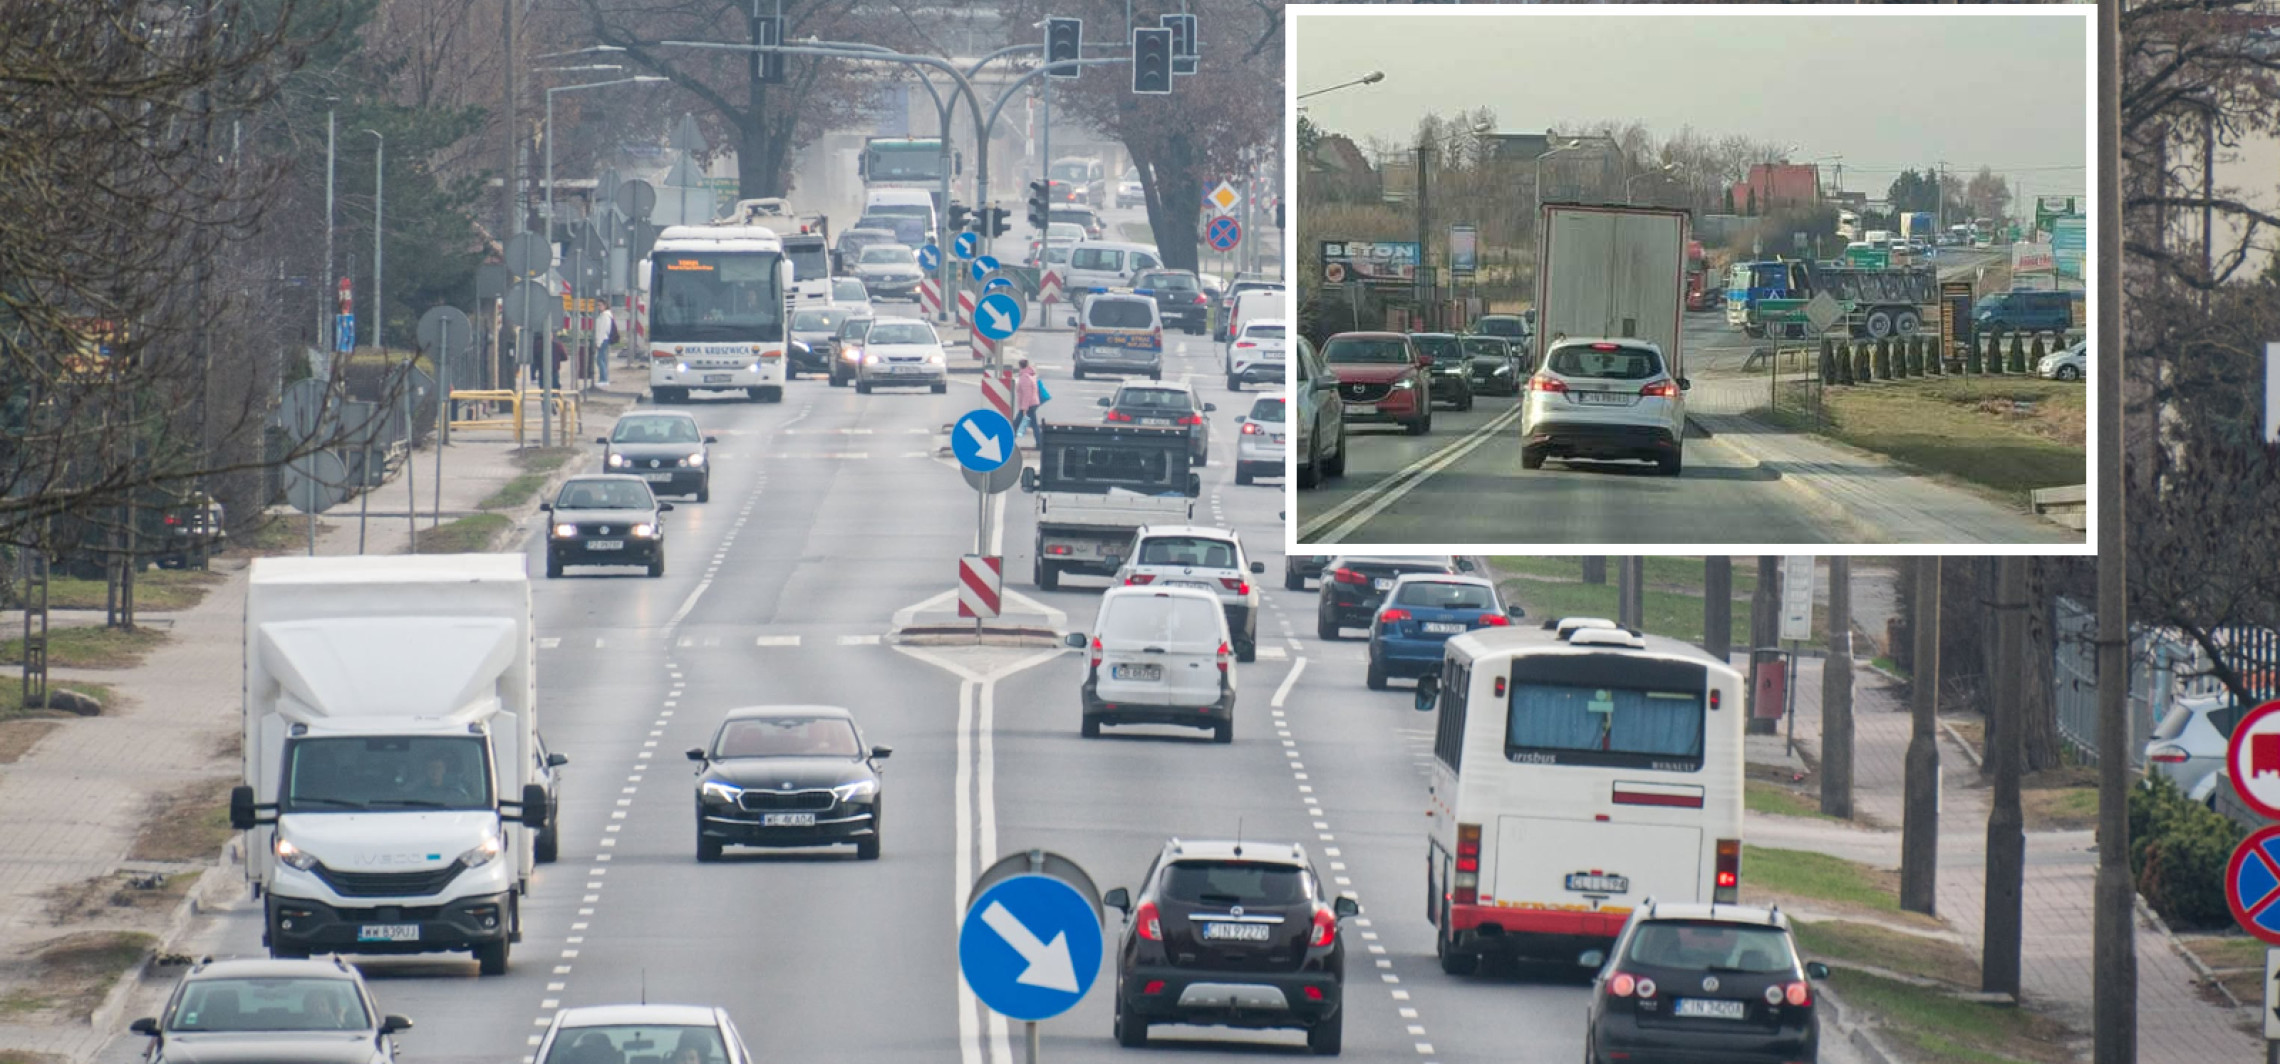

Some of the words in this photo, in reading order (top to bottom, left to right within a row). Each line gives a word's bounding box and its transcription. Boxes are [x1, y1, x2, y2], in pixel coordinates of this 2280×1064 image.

[1326, 242, 1414, 257] BETON
[1652, 761, 1697, 772] RENAULT
[353, 852, 422, 865] IVECO
[1210, 923, 1231, 938] CIN
[1683, 999, 1704, 1014] CIN
